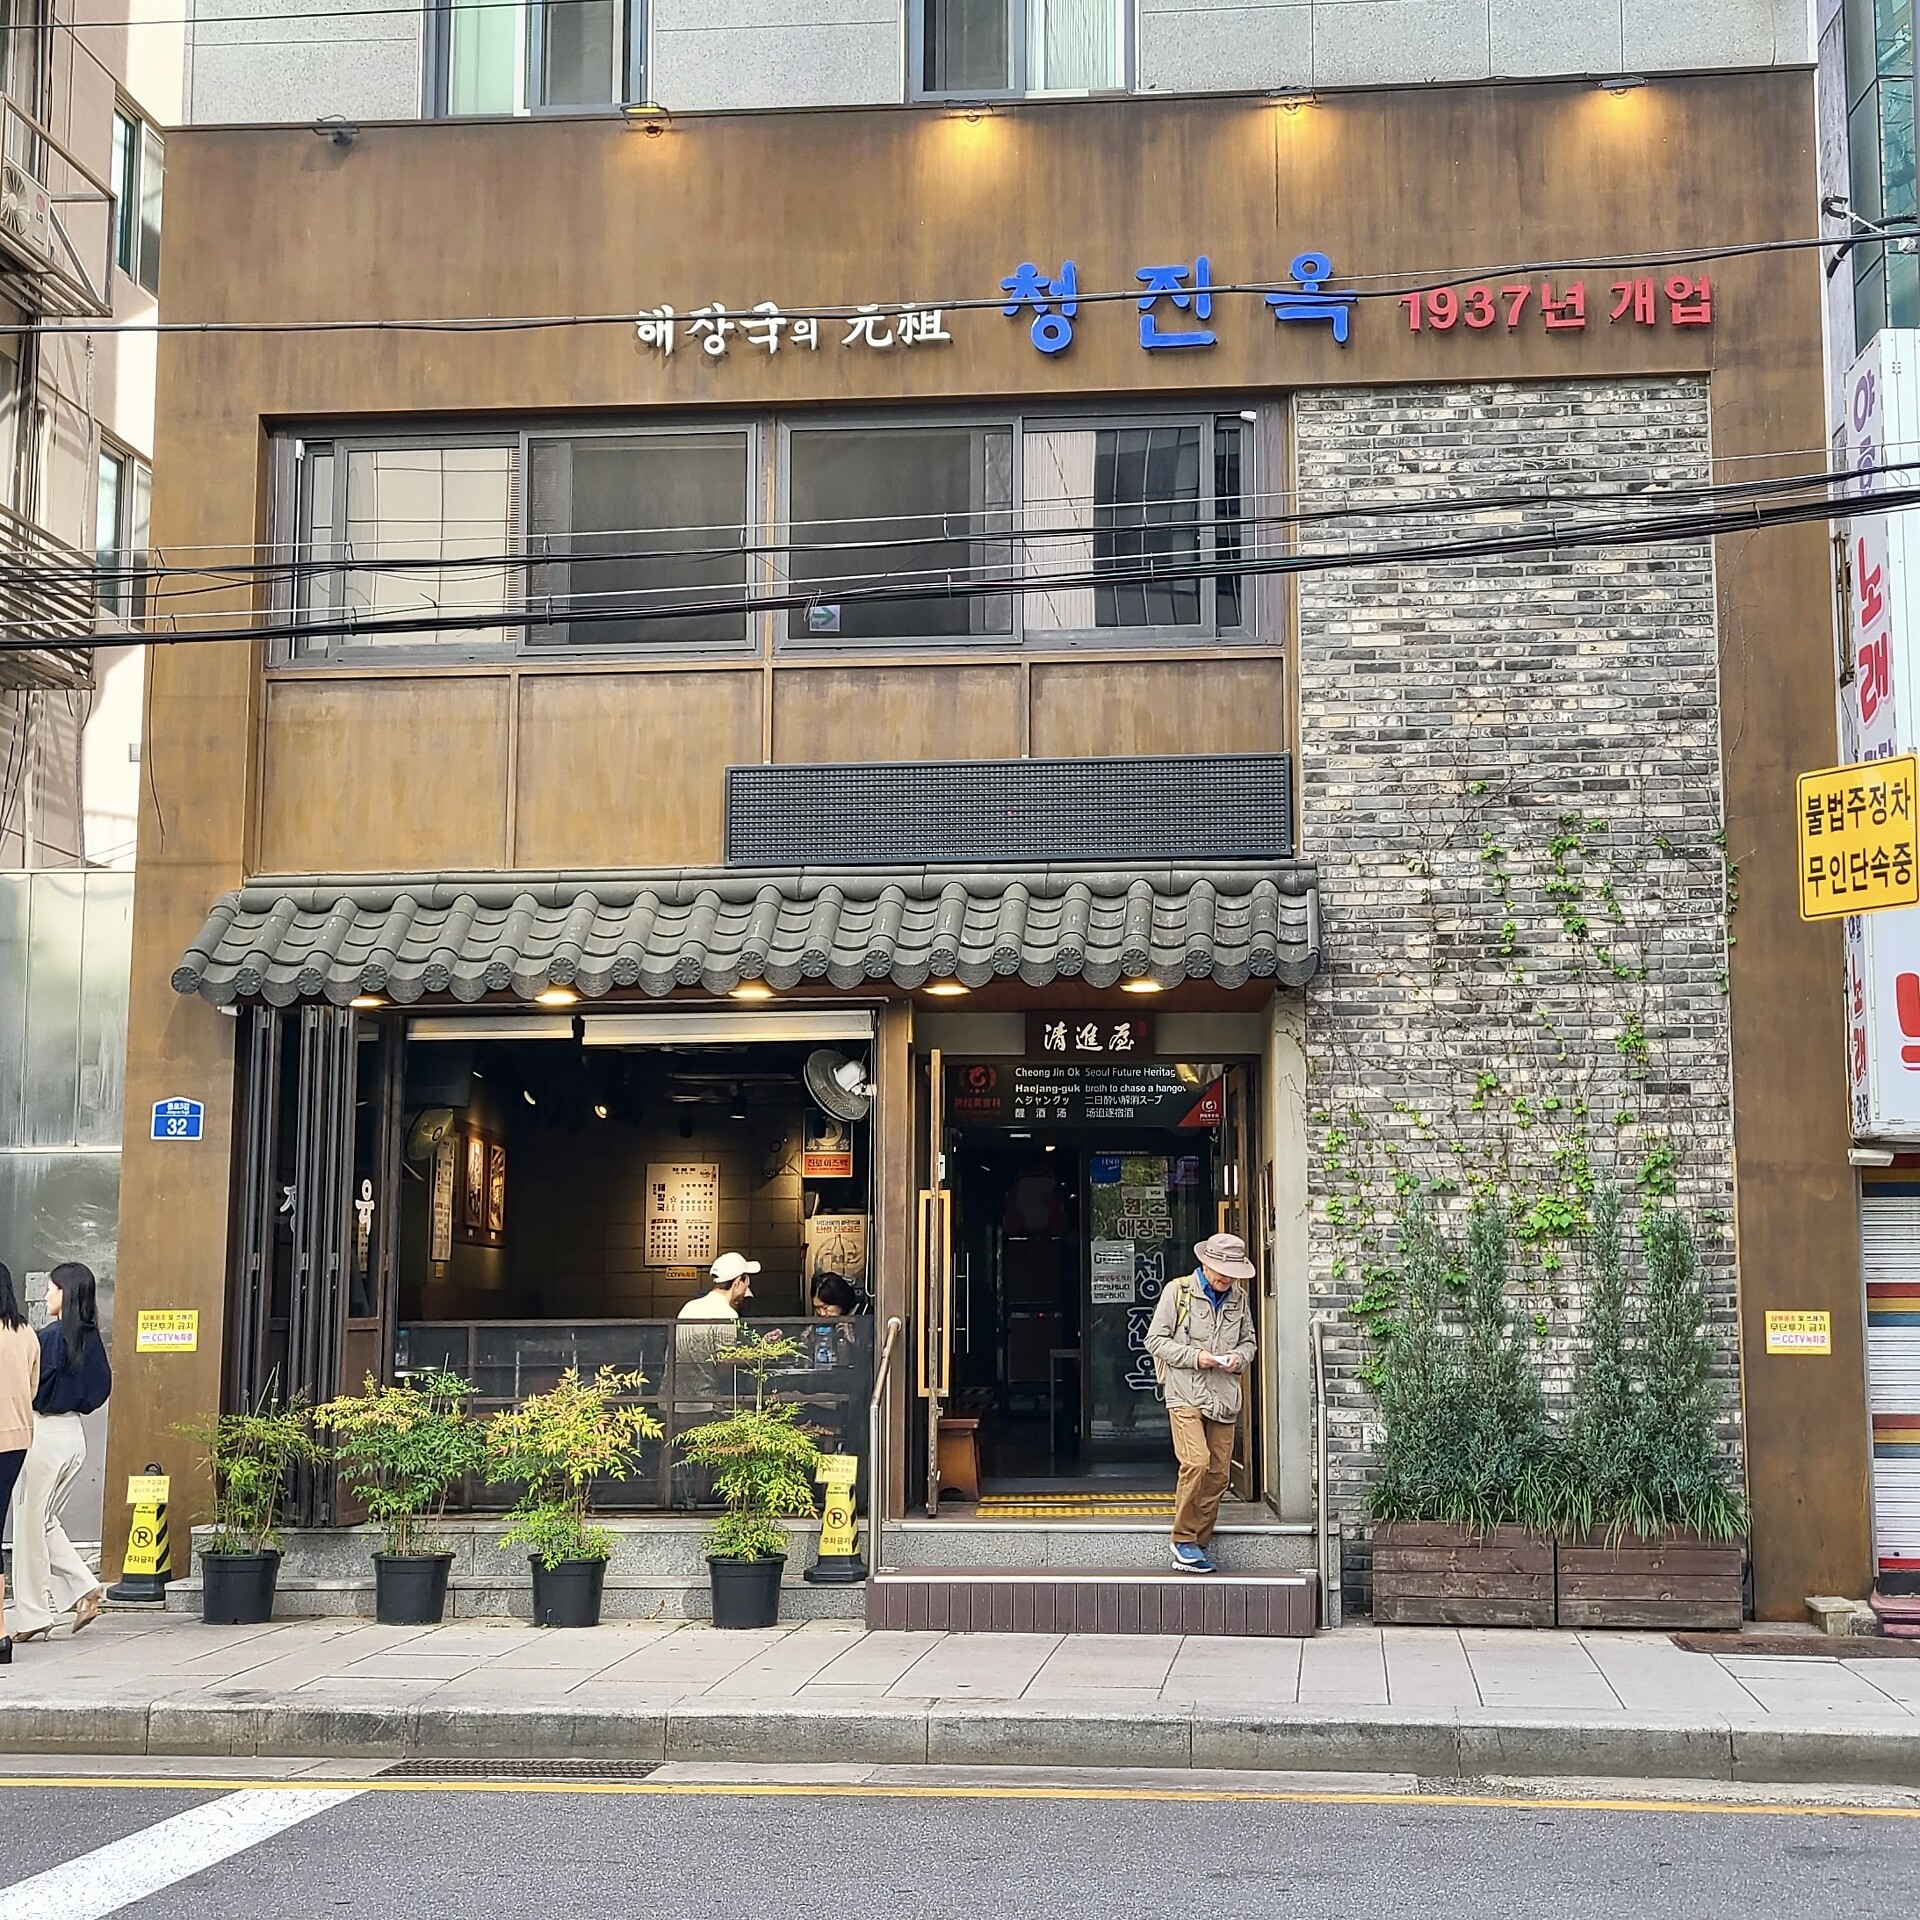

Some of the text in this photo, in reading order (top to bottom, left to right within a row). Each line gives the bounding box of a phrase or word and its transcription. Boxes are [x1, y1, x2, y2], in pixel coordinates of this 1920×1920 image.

[1399, 274, 1713, 333] 1937년 개업
[634, 301, 952, 357] 해장국의 元祖
[1805, 777, 1911, 837] 불법주정차
[1807, 841, 1913, 898] 무인단속중
[1015, 1067, 1176, 1078] Cheong Jin Ok Seoul Future Heritag
[1015, 1084, 1187, 1094] Haejang-guk broth to chase a hangov
[166, 1117, 188, 1136] 32
[1116, 1217, 1174, 1240] 해장국
[141, 1322, 194, 1330] 무단투기 금지
[1770, 1323, 1826, 1332] 무단투기 금지
[823, 1536, 851, 1545] 주차금지
[127, 1555, 155, 1565] 주차금지
